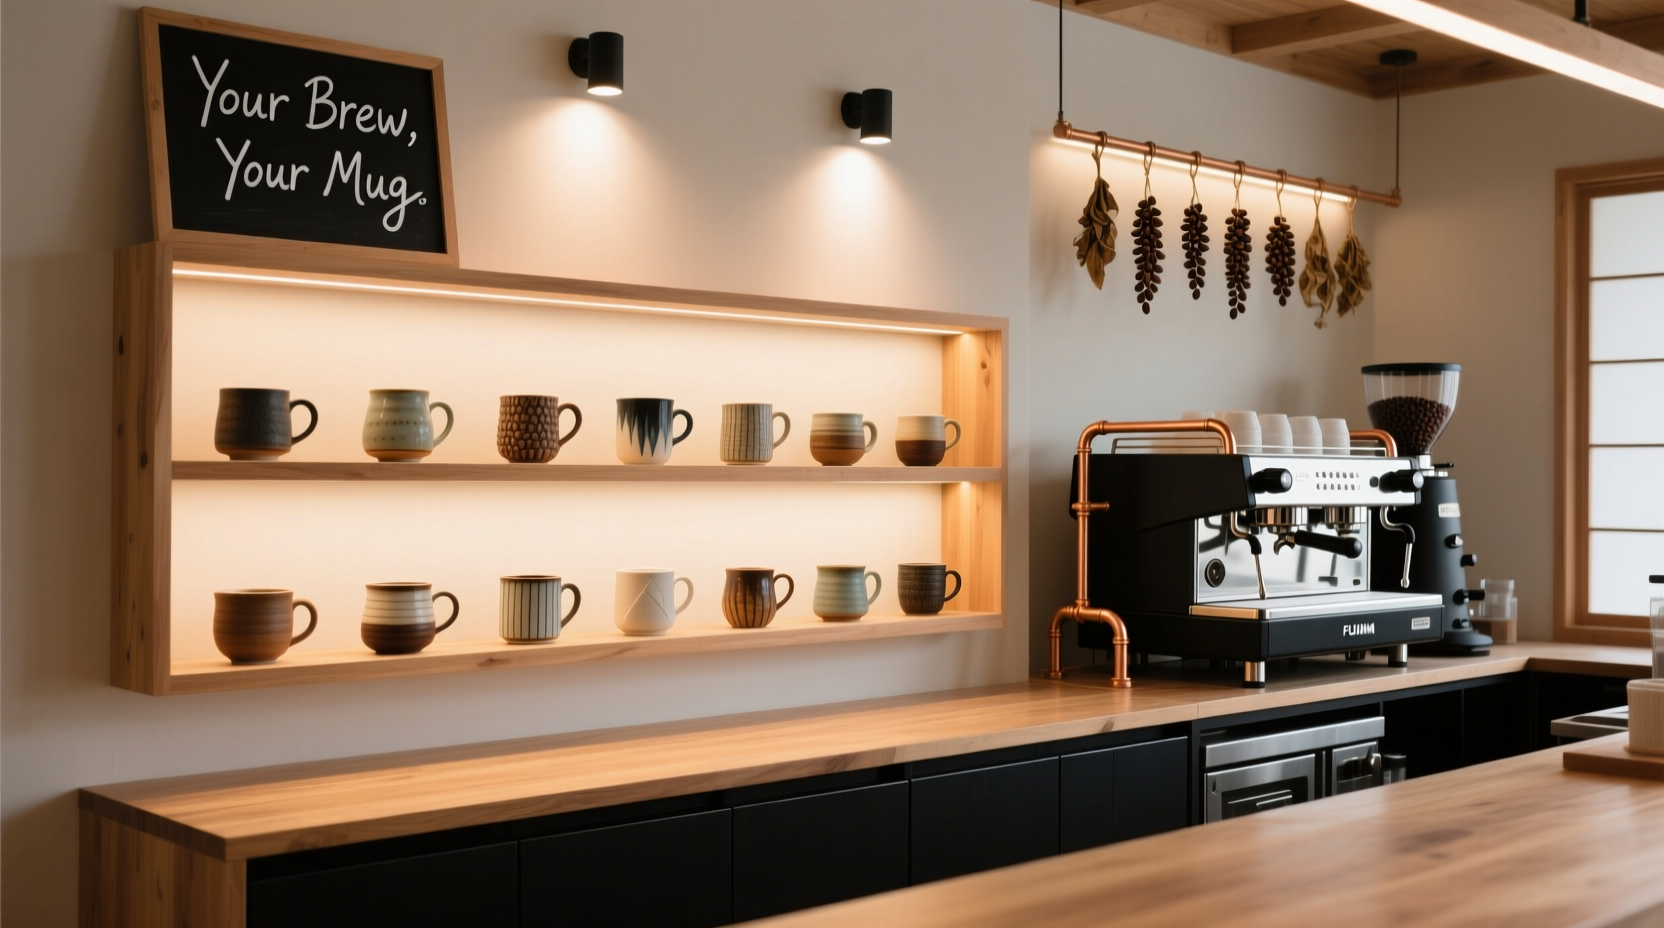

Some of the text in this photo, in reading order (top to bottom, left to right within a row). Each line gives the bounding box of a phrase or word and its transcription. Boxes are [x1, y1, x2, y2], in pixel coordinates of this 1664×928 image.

[191, 54, 417, 148] Your Brew,
[215, 137, 427, 233] Your Mug.
